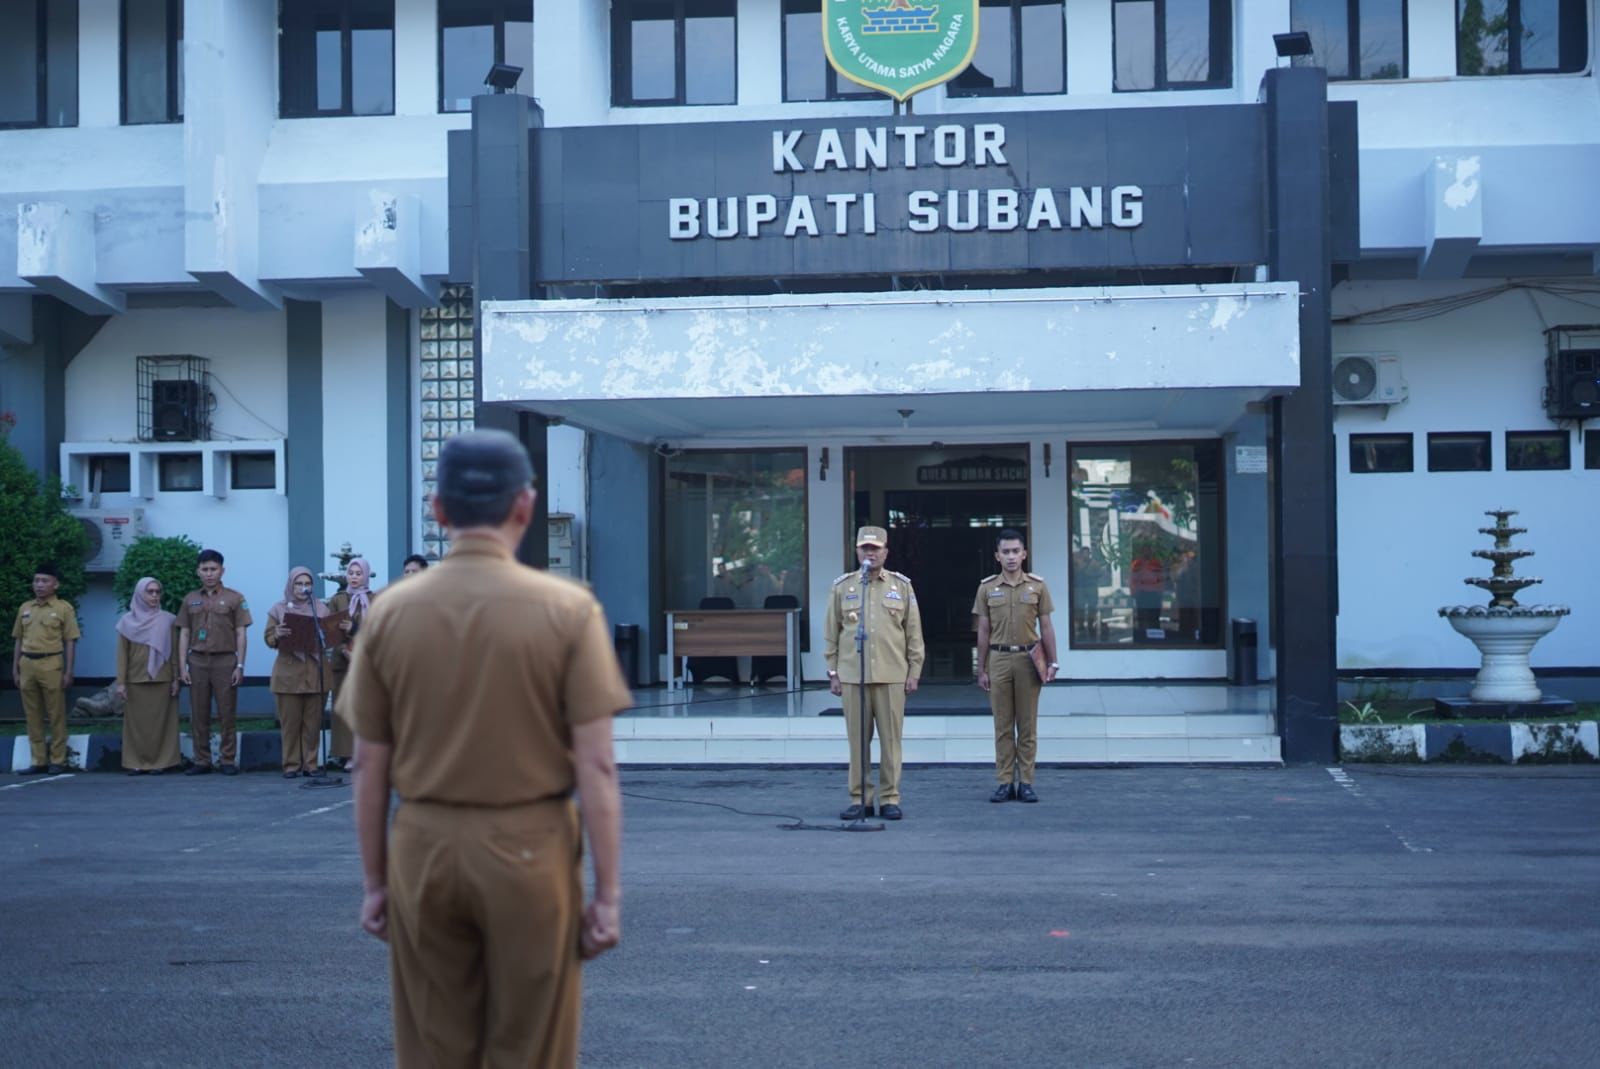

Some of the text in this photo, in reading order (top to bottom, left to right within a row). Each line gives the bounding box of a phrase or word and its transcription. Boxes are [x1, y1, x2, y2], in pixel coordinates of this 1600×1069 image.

[836, 13, 964, 78] KARYA UTAMA SATYA NAGARA
[773, 123, 1008, 172] KANTOR
[668, 185, 1144, 239] BUPATI SUBANG
